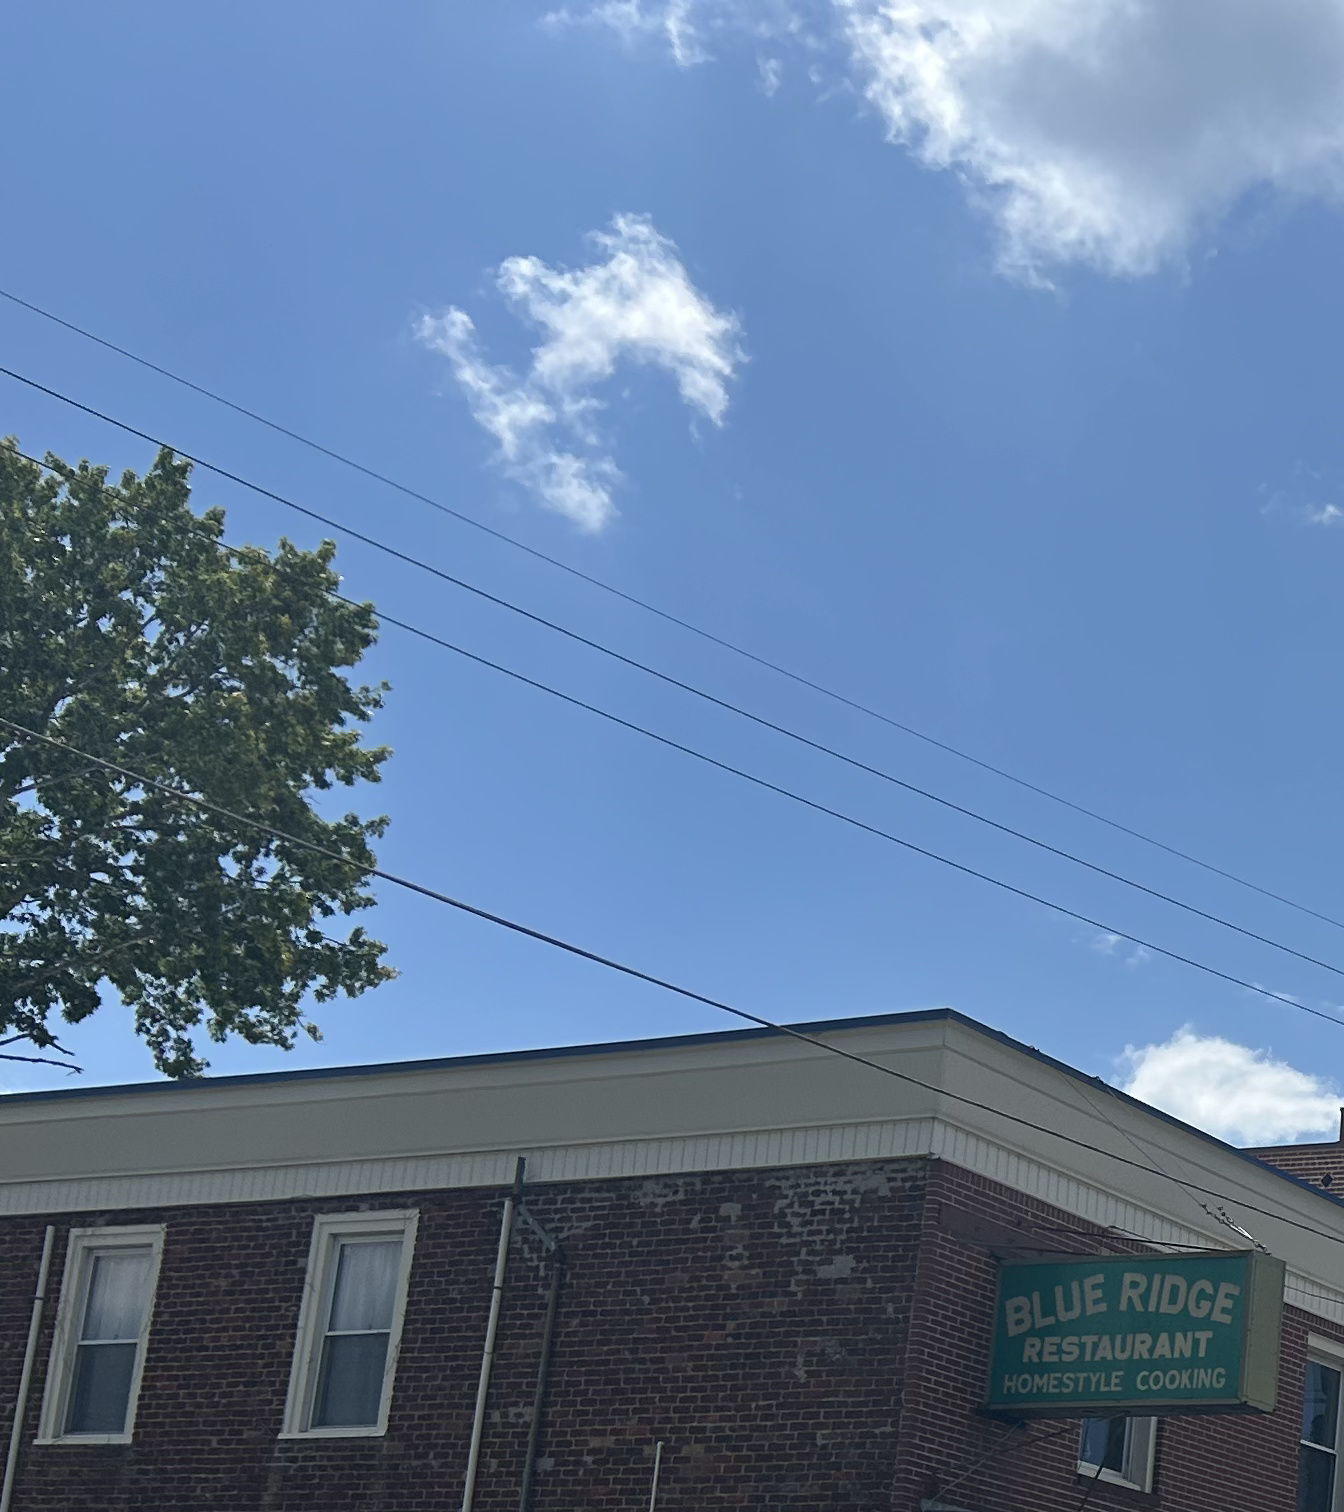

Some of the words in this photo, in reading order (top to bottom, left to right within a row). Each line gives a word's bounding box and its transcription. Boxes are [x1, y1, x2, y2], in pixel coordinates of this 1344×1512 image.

[1005, 1273, 1108, 1337] BLUE
[1119, 1272, 1241, 1325] RIDGE
[1022, 1330, 1214, 1363] RESTAURANT
[1002, 1370, 1125, 1394] HOMESTYLE
[1136, 1367, 1227, 1390] COOKING
